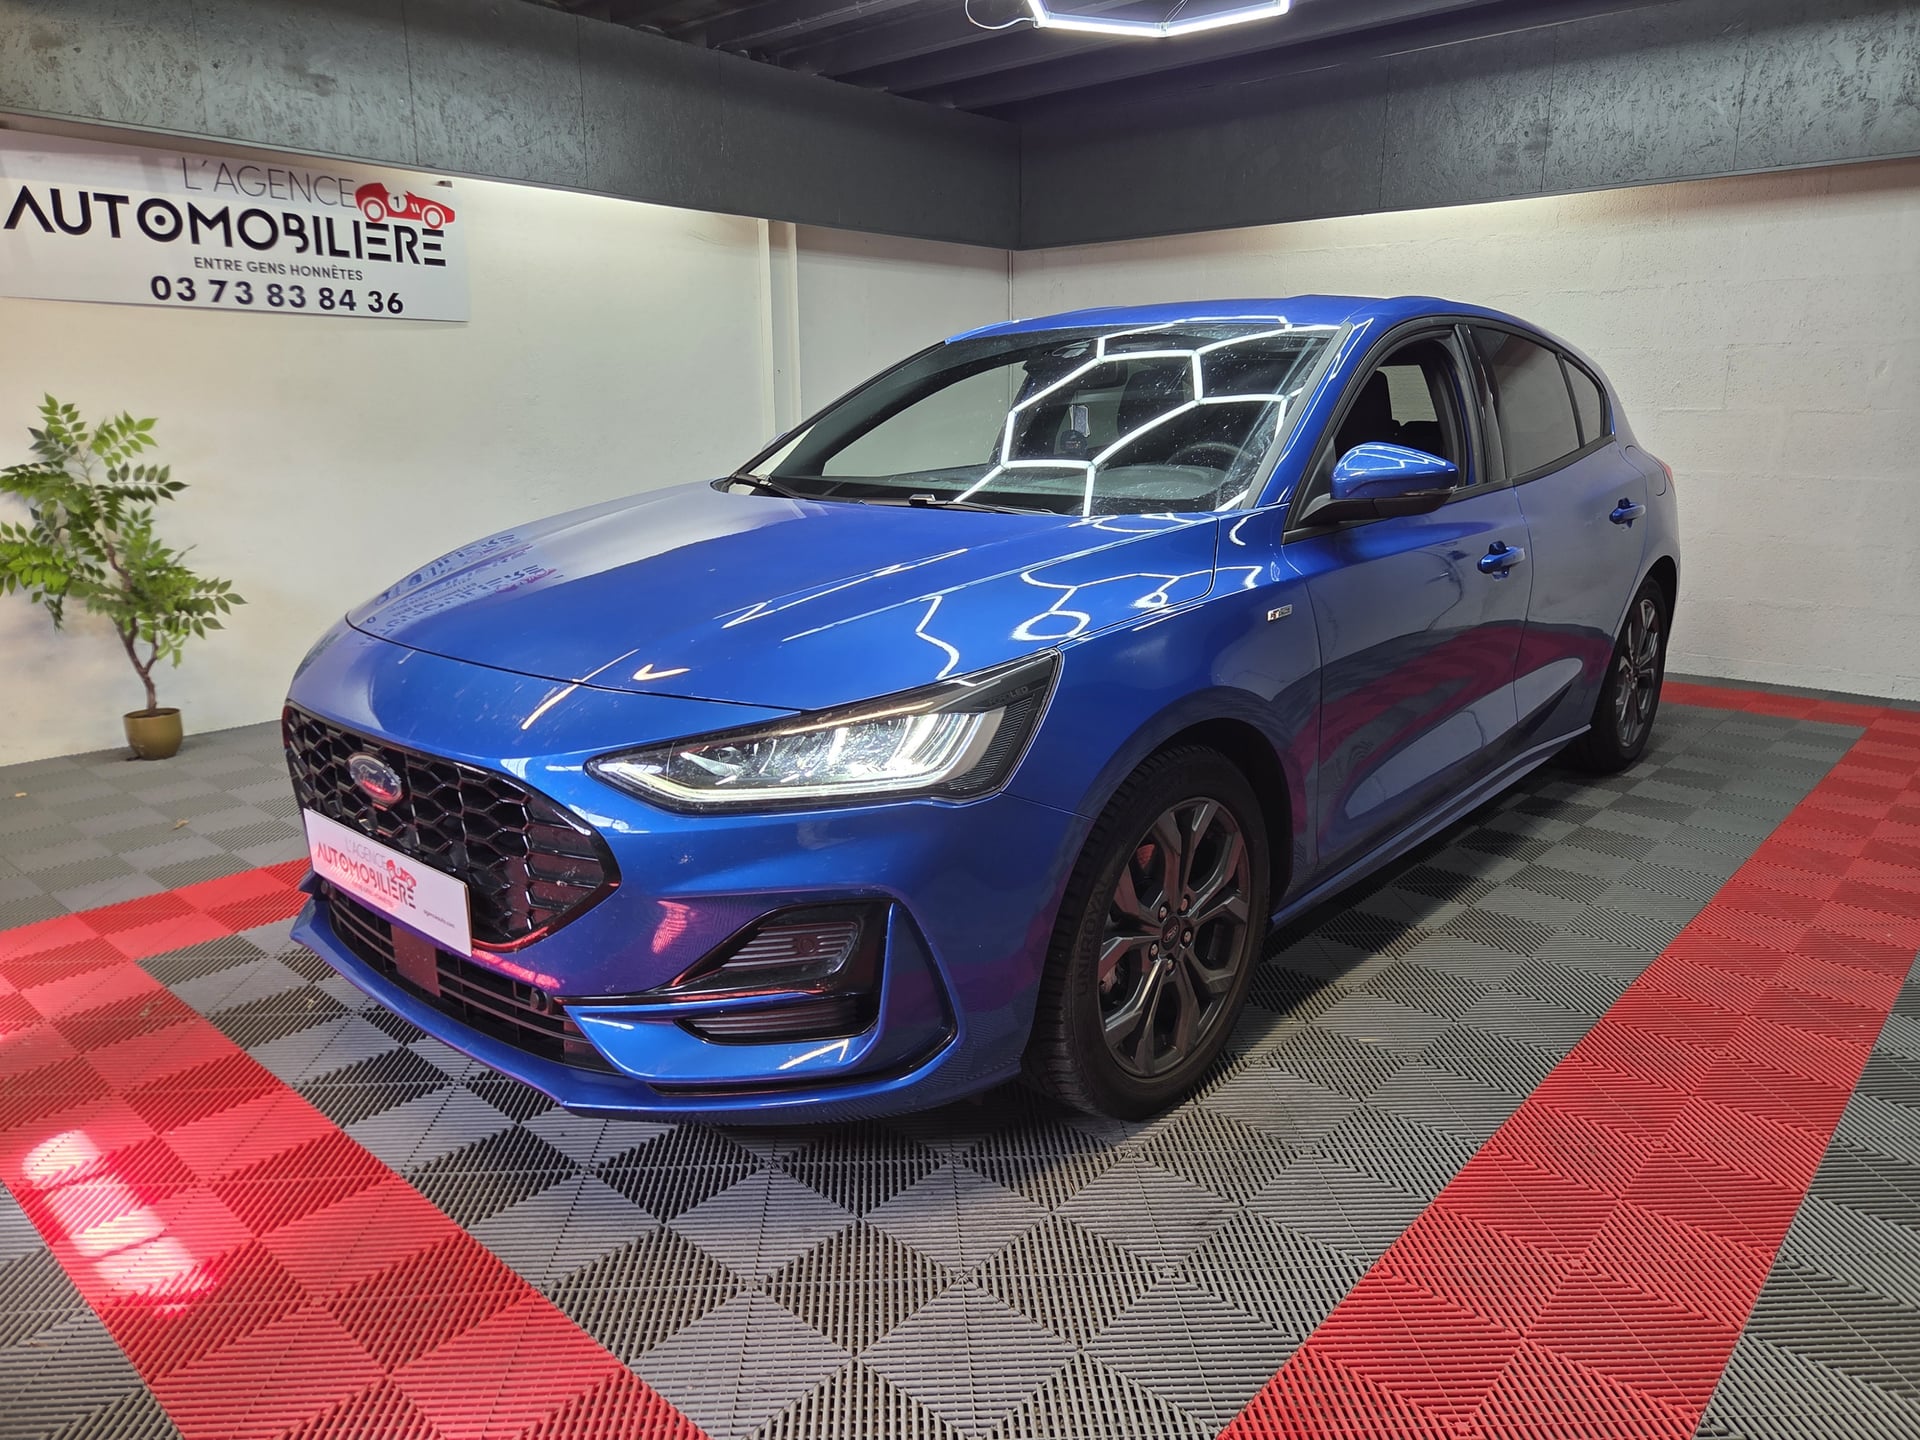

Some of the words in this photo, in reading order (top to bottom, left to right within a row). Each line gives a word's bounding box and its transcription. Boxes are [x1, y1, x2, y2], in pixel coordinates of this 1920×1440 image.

[3, 185, 446, 267] AUTOMOBILIERE
[193, 256, 243, 272] ENTRE
[246, 261, 286, 275] GENS
[290, 263, 364, 281] HONNÊTES
[150, 275, 197, 302] 03
[208, 279, 254, 305] 73
[266, 283, 307, 309] 83
[318, 287, 357, 312] 84
[367, 290, 404, 315] 36
